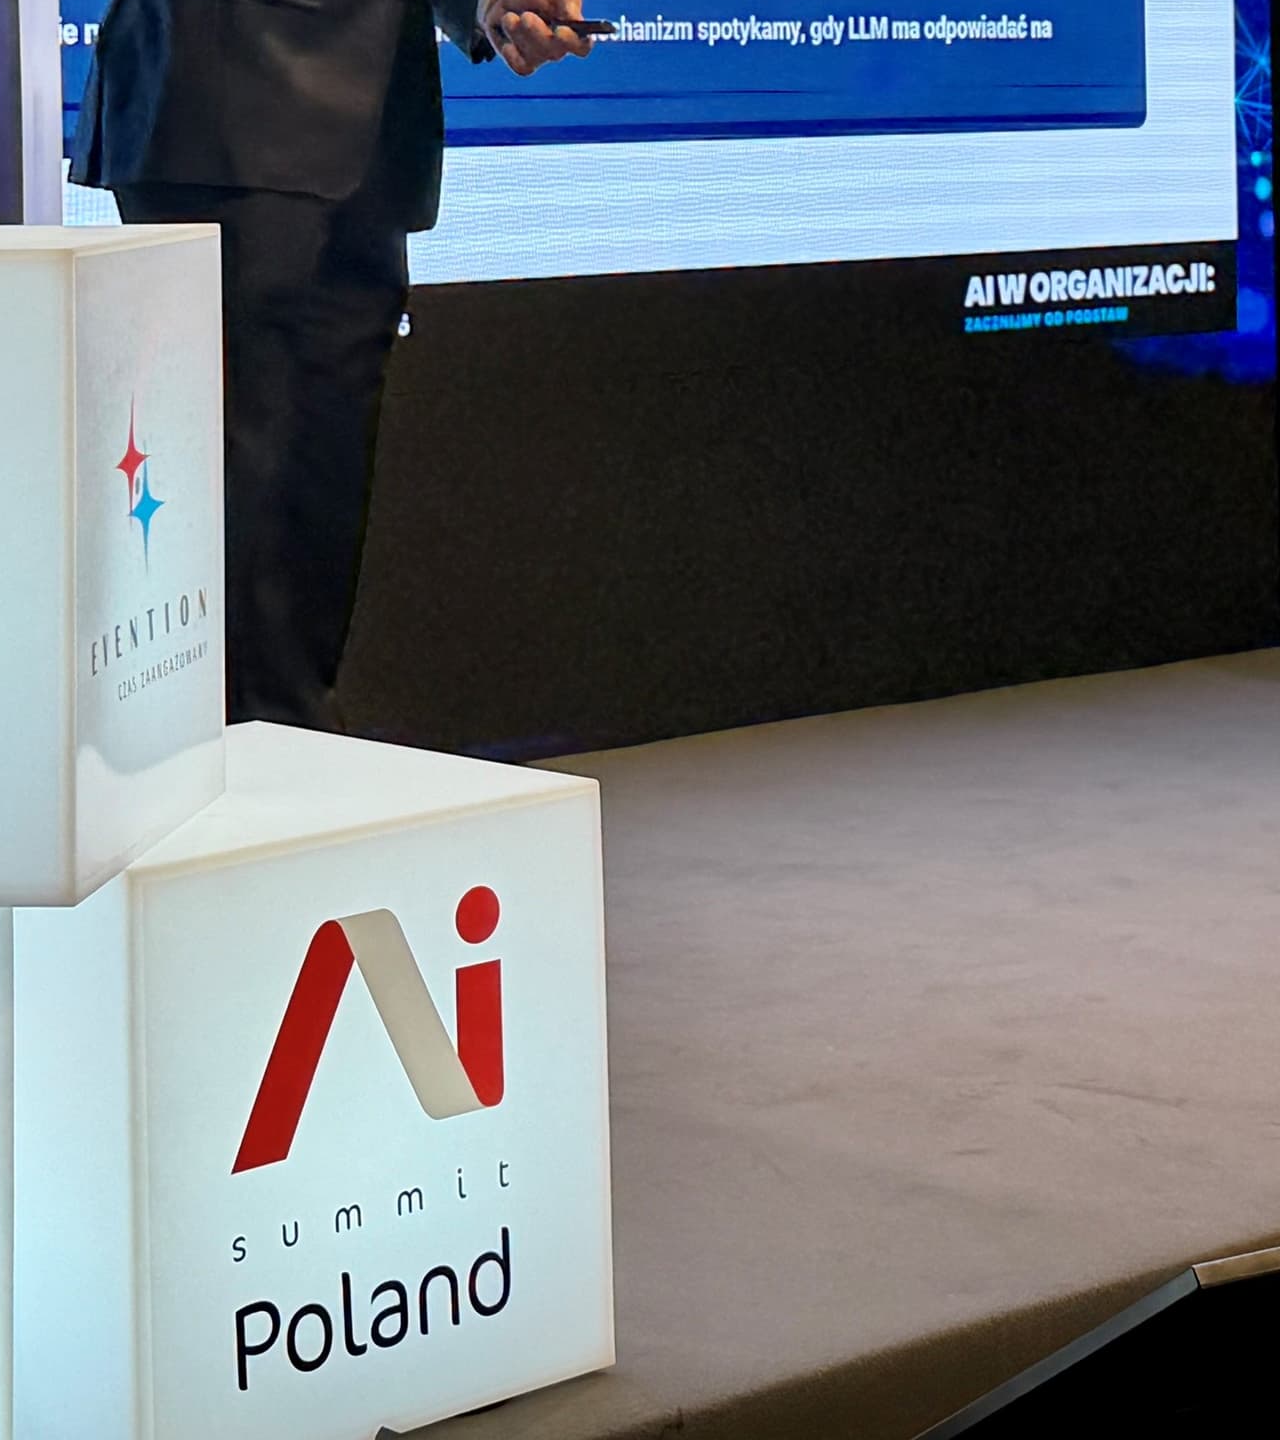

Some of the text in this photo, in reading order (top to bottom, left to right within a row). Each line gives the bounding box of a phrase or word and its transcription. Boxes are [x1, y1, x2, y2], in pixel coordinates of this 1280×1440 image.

[697, 17, 805, 48] spotykamy,
[811, 16, 843, 46] gdy
[848, 16, 887, 40] LLM
[892, 20, 920, 40] ma
[924, 13, 1027, 46] odpowiadać
[1030, 19, 1052, 39] na
[965, 263, 1215, 307] AI W ORGANIZACJI:
[231, 1160, 510, 1262] summit
[235, 1226, 511, 1391] Poland
